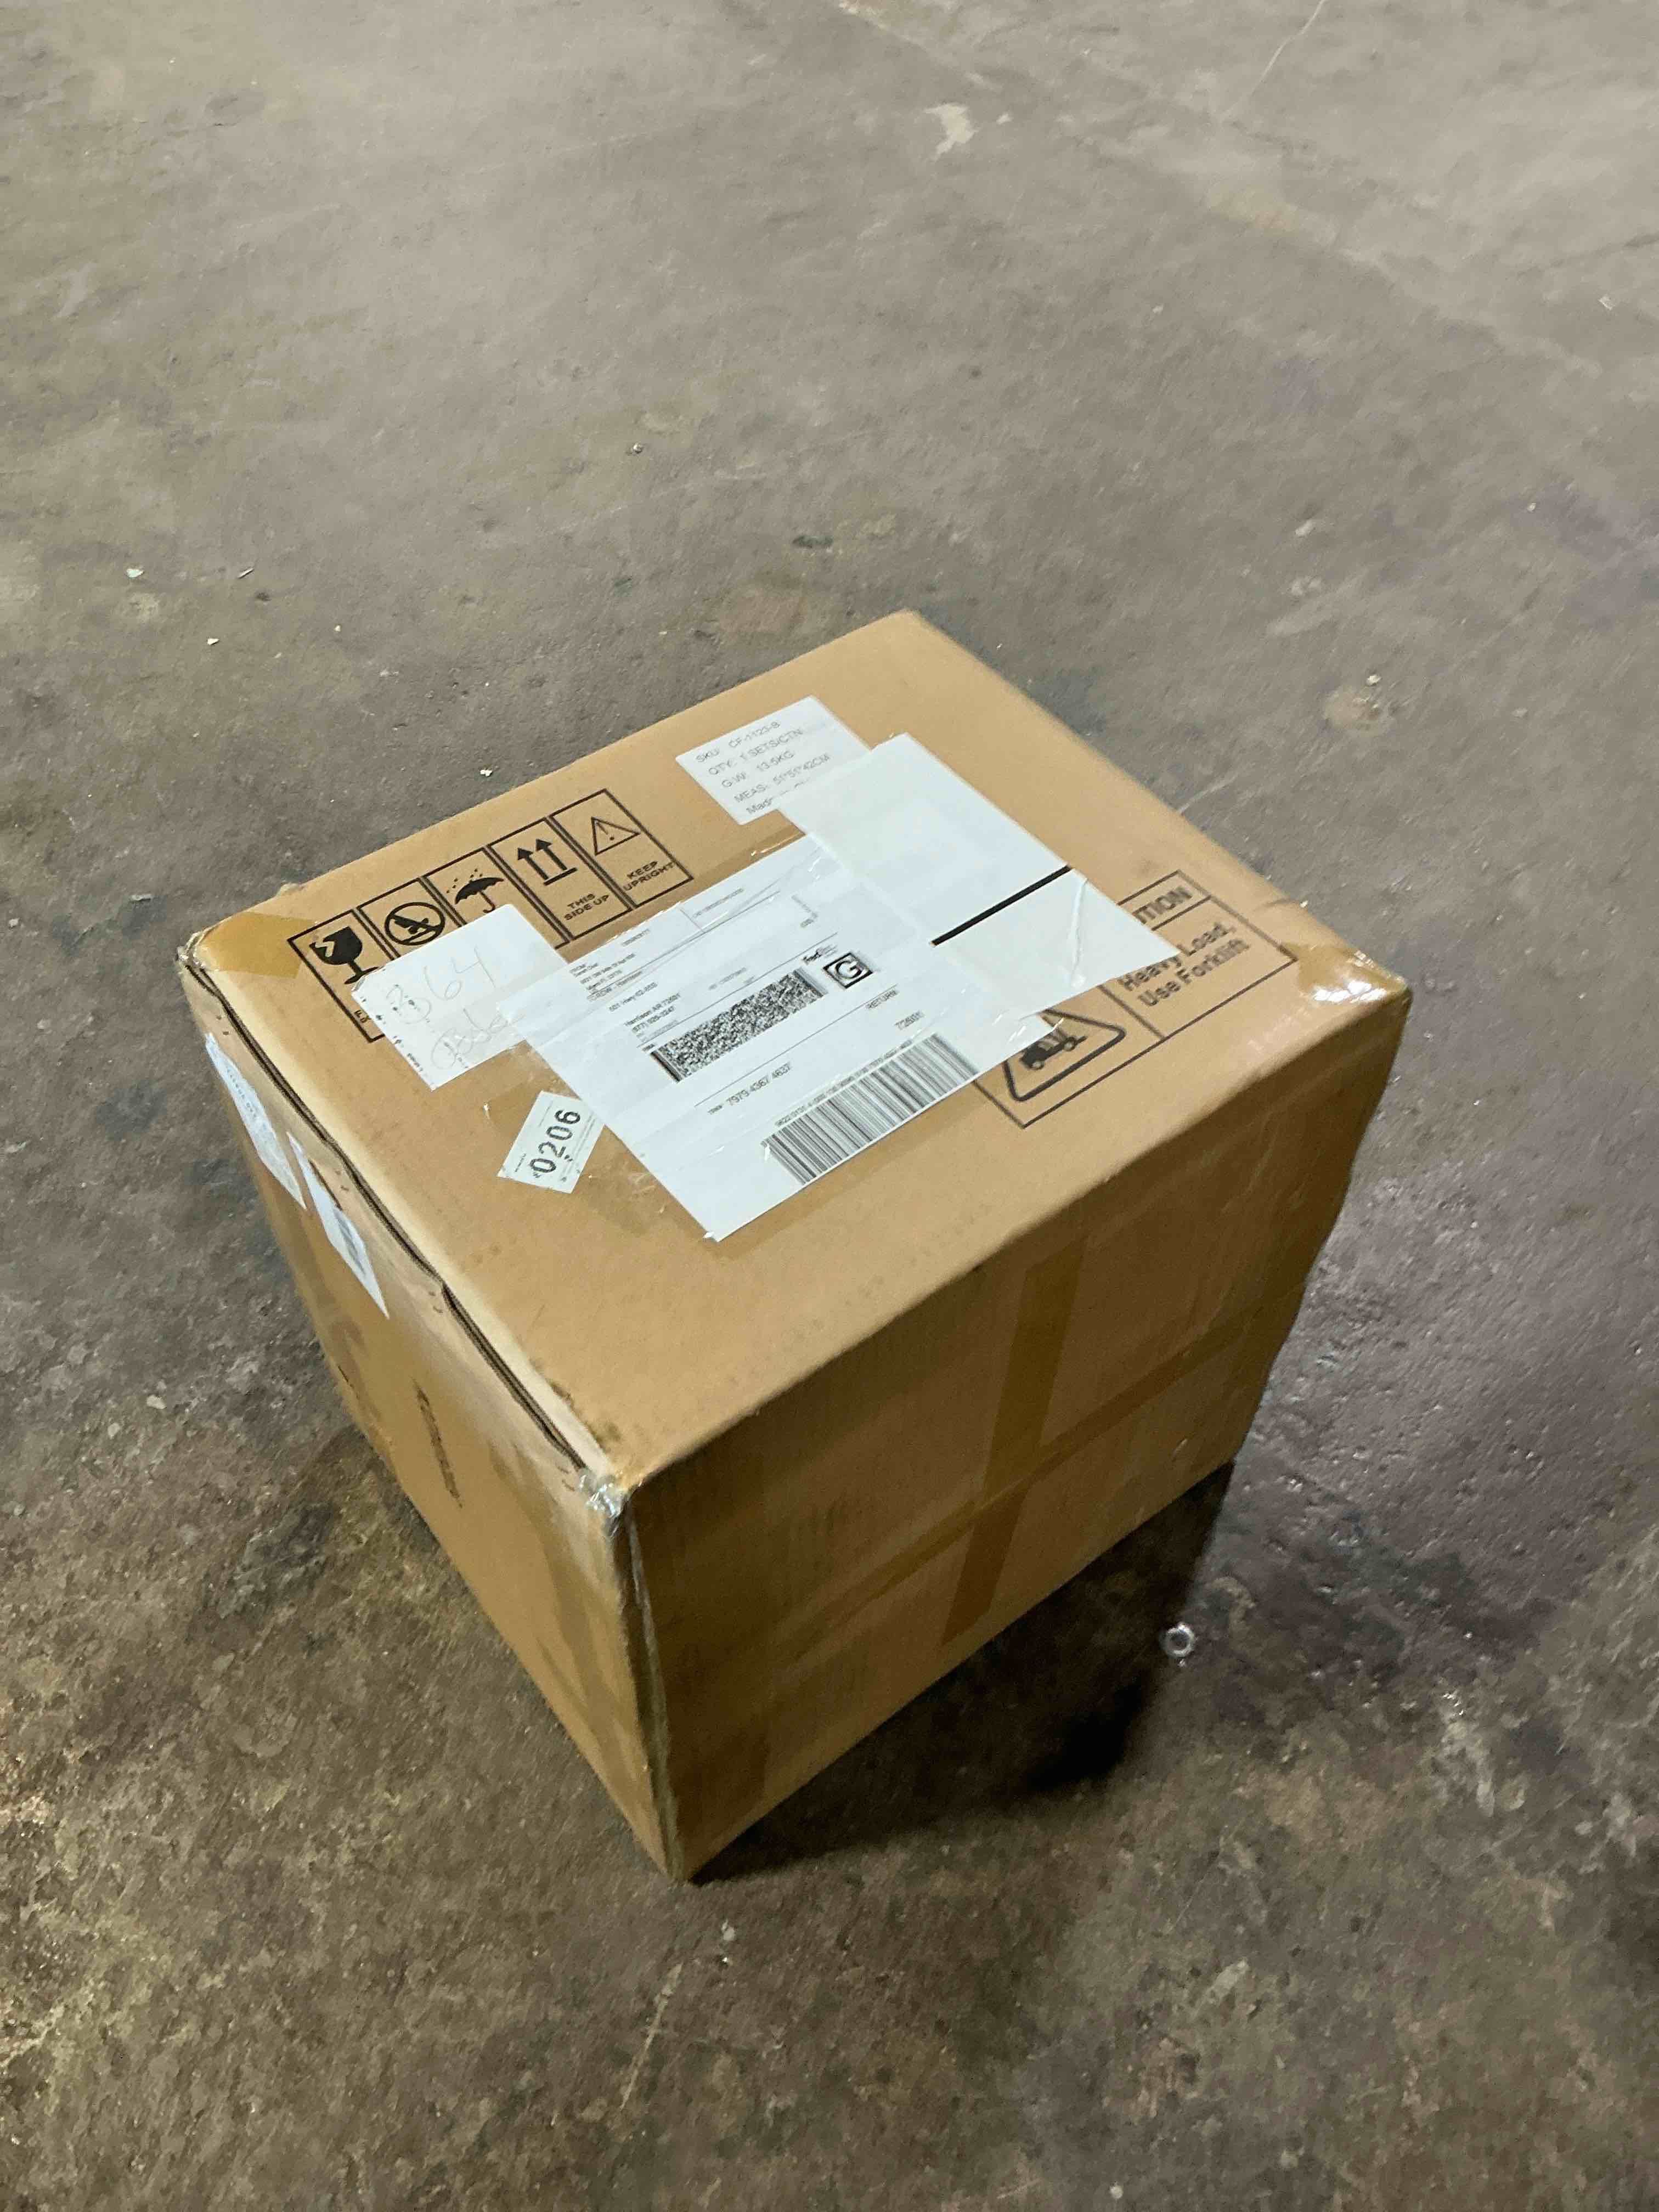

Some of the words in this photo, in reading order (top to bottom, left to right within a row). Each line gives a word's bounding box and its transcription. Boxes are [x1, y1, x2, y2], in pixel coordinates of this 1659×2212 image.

[623, 861, 675, 891] UPRIGHT
[627, 860, 659, 879] KEEP
[564, 902, 591, 921] SIDE
[595, 894, 611, 906] UP
[567, 893, 596, 910] THIS
[834, 960, 862, 979] G
[1137, 980, 1181, 1007] Use
[528, 1109, 582, 1174] 0206
